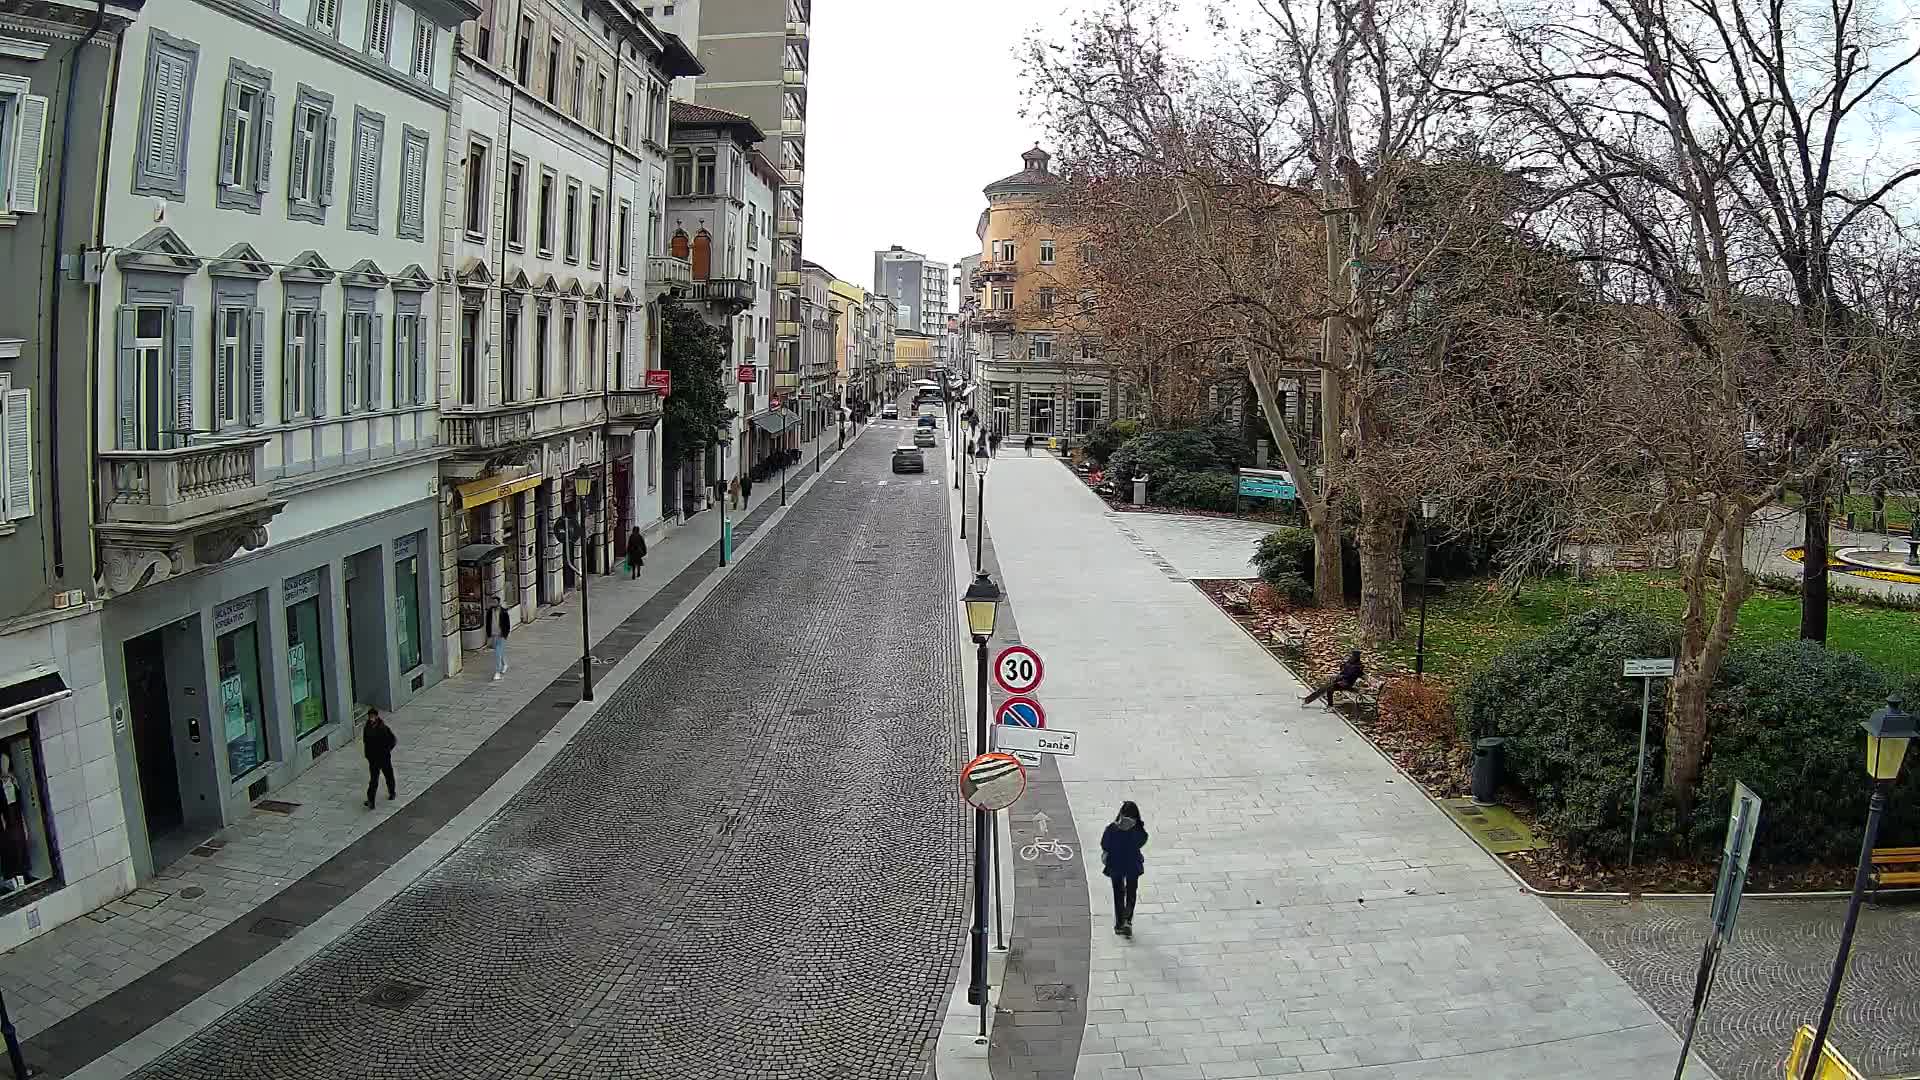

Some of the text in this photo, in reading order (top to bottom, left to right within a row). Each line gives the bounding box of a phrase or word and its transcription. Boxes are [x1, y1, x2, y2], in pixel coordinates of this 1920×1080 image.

[1006, 659, 1033, 681] 30
[222, 678, 240, 701] 130
[1039, 739, 1070, 750] Dante
